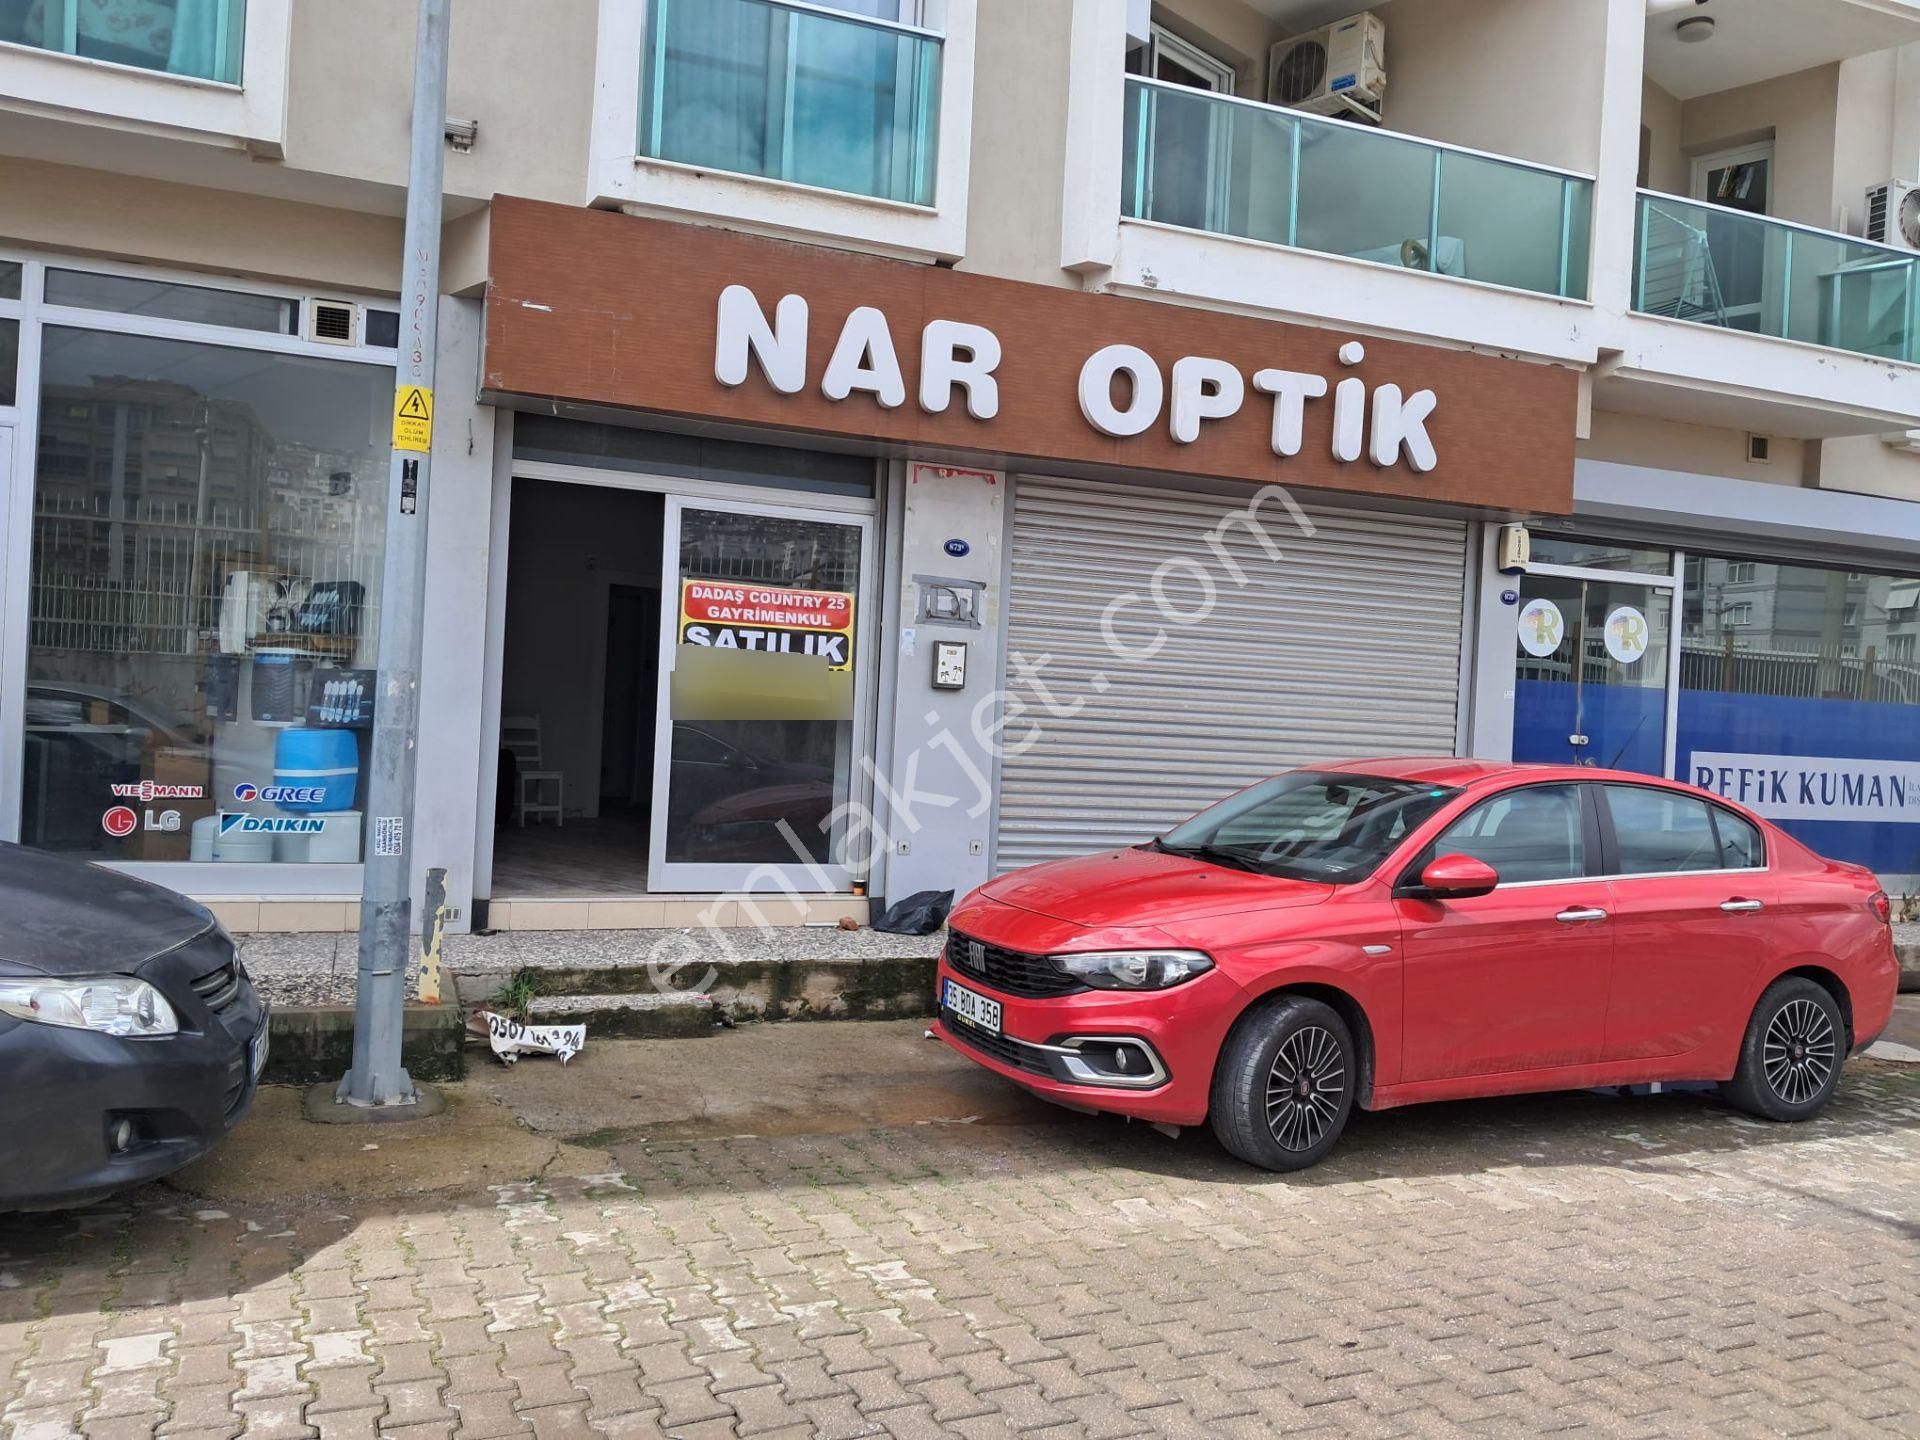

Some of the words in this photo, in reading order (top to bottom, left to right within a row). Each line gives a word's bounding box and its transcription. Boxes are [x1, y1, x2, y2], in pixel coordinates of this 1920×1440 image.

[714, 284, 1002, 420] NAR
[1078, 340, 1438, 473] OPTİK
[691, 586, 744, 605] DADAŞ
[749, 591, 824, 608] COUNTRY
[826, 598, 845, 610] 25
[706, 606, 832, 627] GAYRİMENKUL
[111, 781, 202, 800] VIESSMANN
[260, 787, 326, 802] GREE
[1798, 771, 1906, 808] KUMAN
[143, 810, 181, 832] LG
[243, 818, 325, 833] DAIKIN
[948, 984, 957, 1008] 35
[980, 1000, 999, 1027] 358
